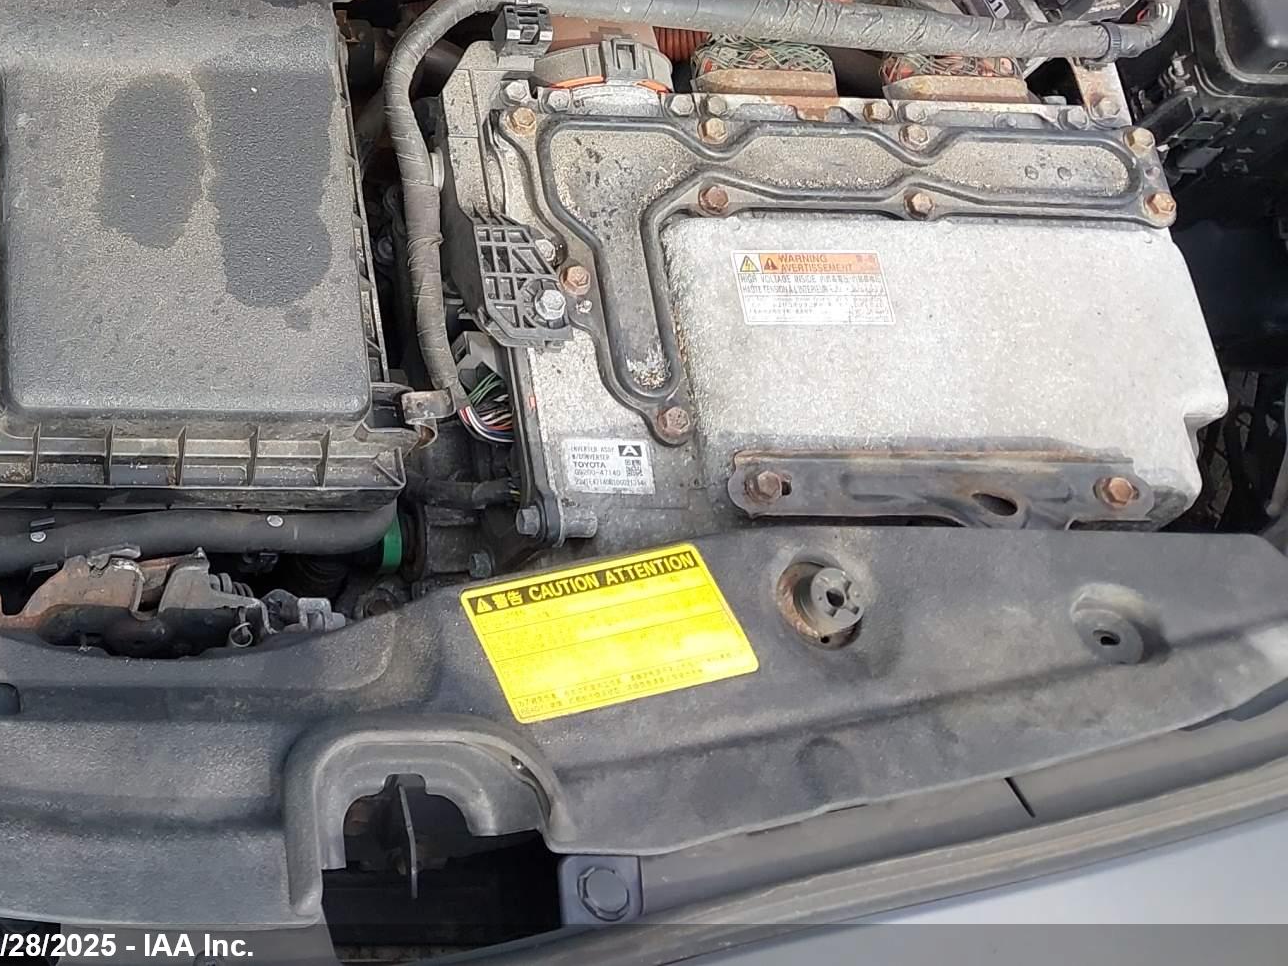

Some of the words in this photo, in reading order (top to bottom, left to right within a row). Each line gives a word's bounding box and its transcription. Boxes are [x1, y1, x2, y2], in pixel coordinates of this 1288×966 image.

[778, 254, 828, 263] WARNING
[528, 573, 600, 602] CAUTION
[606, 552, 696, 585] ATTENTION
